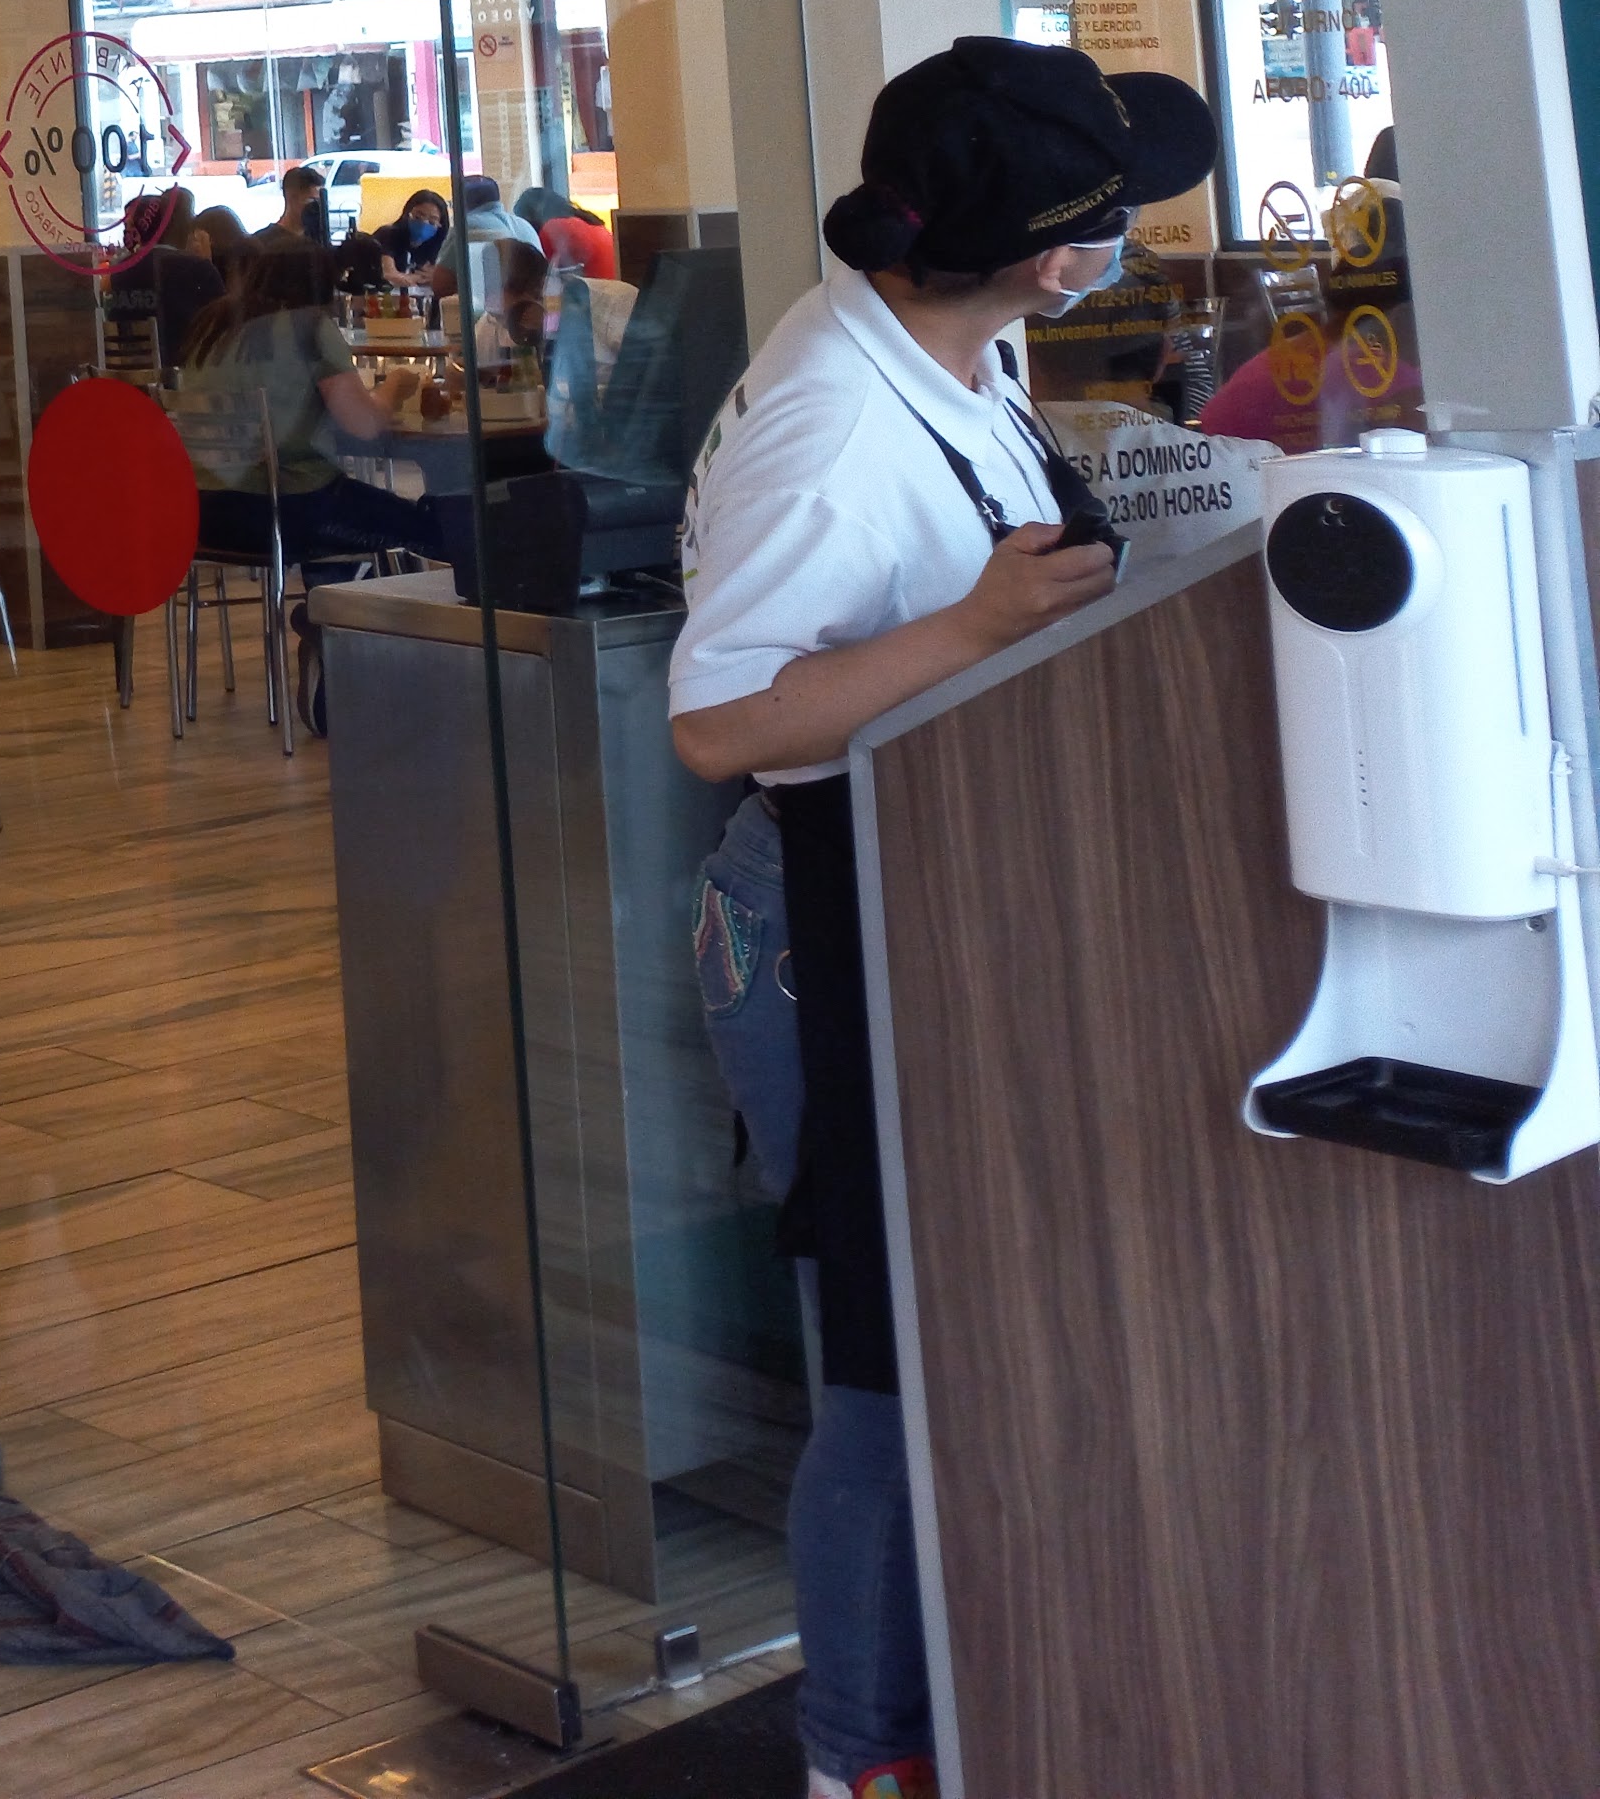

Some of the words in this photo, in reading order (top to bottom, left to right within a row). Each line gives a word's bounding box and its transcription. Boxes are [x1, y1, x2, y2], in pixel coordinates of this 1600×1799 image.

[1043, 3, 1098, 15] PROPSITO
[1100, 3, 1137, 14] IMPEDIR
[1055, 22, 1082, 32] GOE
[1085, 21, 1090, 31] Y
[1093, 21, 1141, 32] EJERCICIO
[1113, 37, 1159, 49] HUMANOS
[1253, 77, 1332, 105] AFORO:
[1099, 452, 1113, 481] A
[1117, 441, 1211, 480] DOMINGO
[1108, 491, 1158, 524] 23:00
[1164, 481, 1233, 516] HORAS
